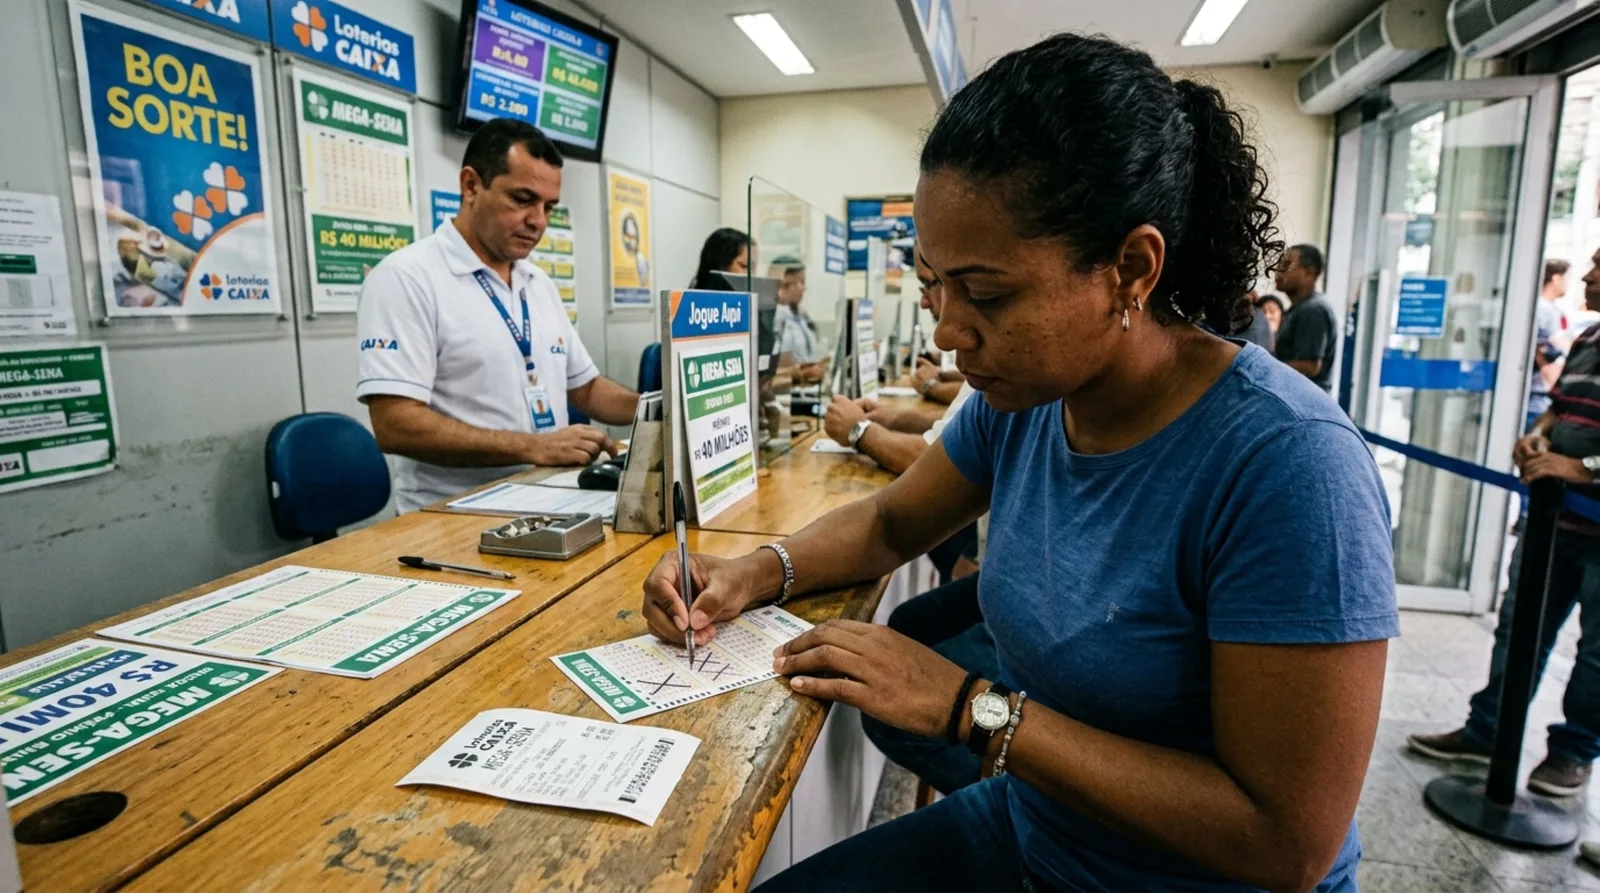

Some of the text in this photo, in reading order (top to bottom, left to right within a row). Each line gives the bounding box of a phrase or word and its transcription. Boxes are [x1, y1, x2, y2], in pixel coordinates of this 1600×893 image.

[334, 14, 400, 56] Loterias
[123, 42, 218, 104] BOA
[335, 40, 401, 81] CAIXA
[106, 86, 248, 152] SORTE!
[320, 230, 337, 247] R$
[340, 232, 356, 247] 40
[228, 286, 270, 301] CAIXA
[689, 301, 719, 330] Jogue
[360, 338, 398, 351] CAIXA
[702, 440, 713, 460] 40
[714, 424, 749, 455] MILHÕES
[354, 604, 475, 663] MEGA-SENA
[119, 660, 179, 683] R$
